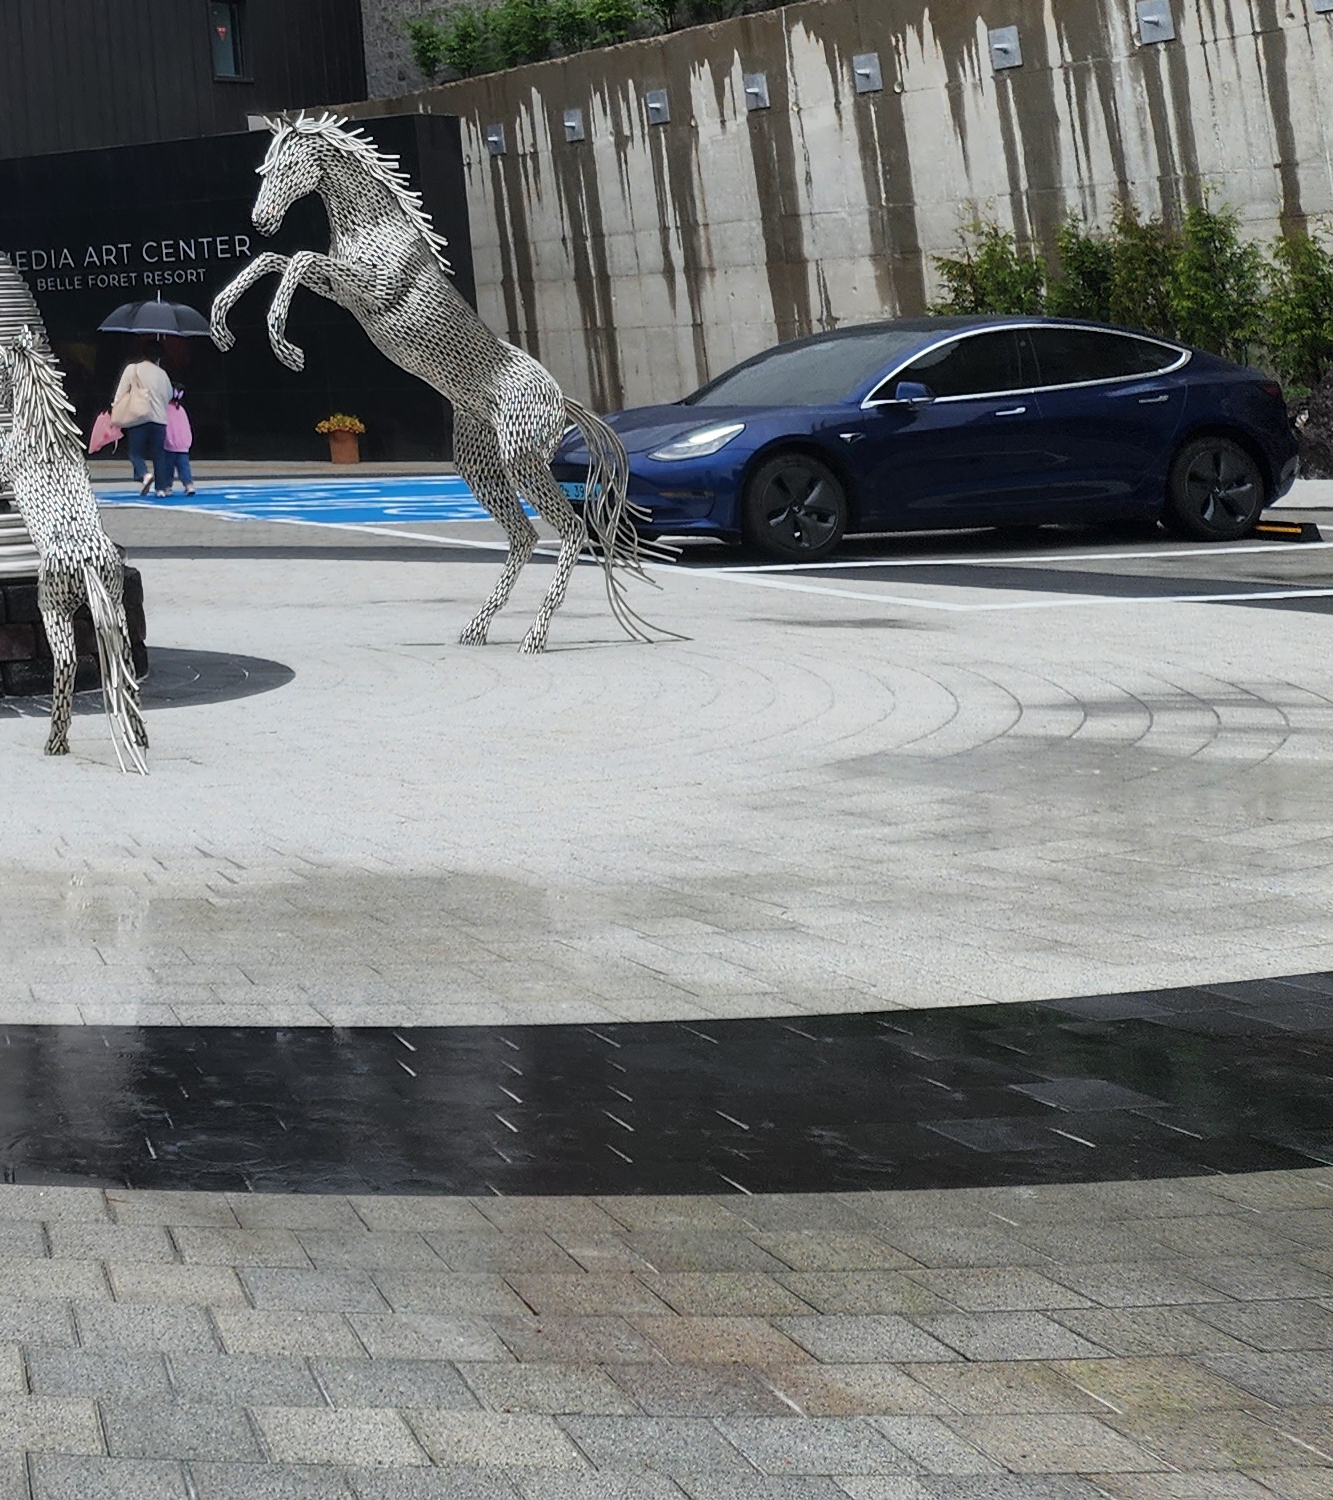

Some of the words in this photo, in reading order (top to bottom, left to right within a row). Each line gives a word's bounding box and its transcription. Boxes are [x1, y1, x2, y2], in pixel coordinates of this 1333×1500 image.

[6, 248, 75, 271] EDIA
[83, 243, 132, 267] ART
[142, 235, 251, 263] CENTER
[37, 276, 83, 291] BELLE
[88, 272, 138, 288] FORET
[143, 268, 206, 285] RESORT
